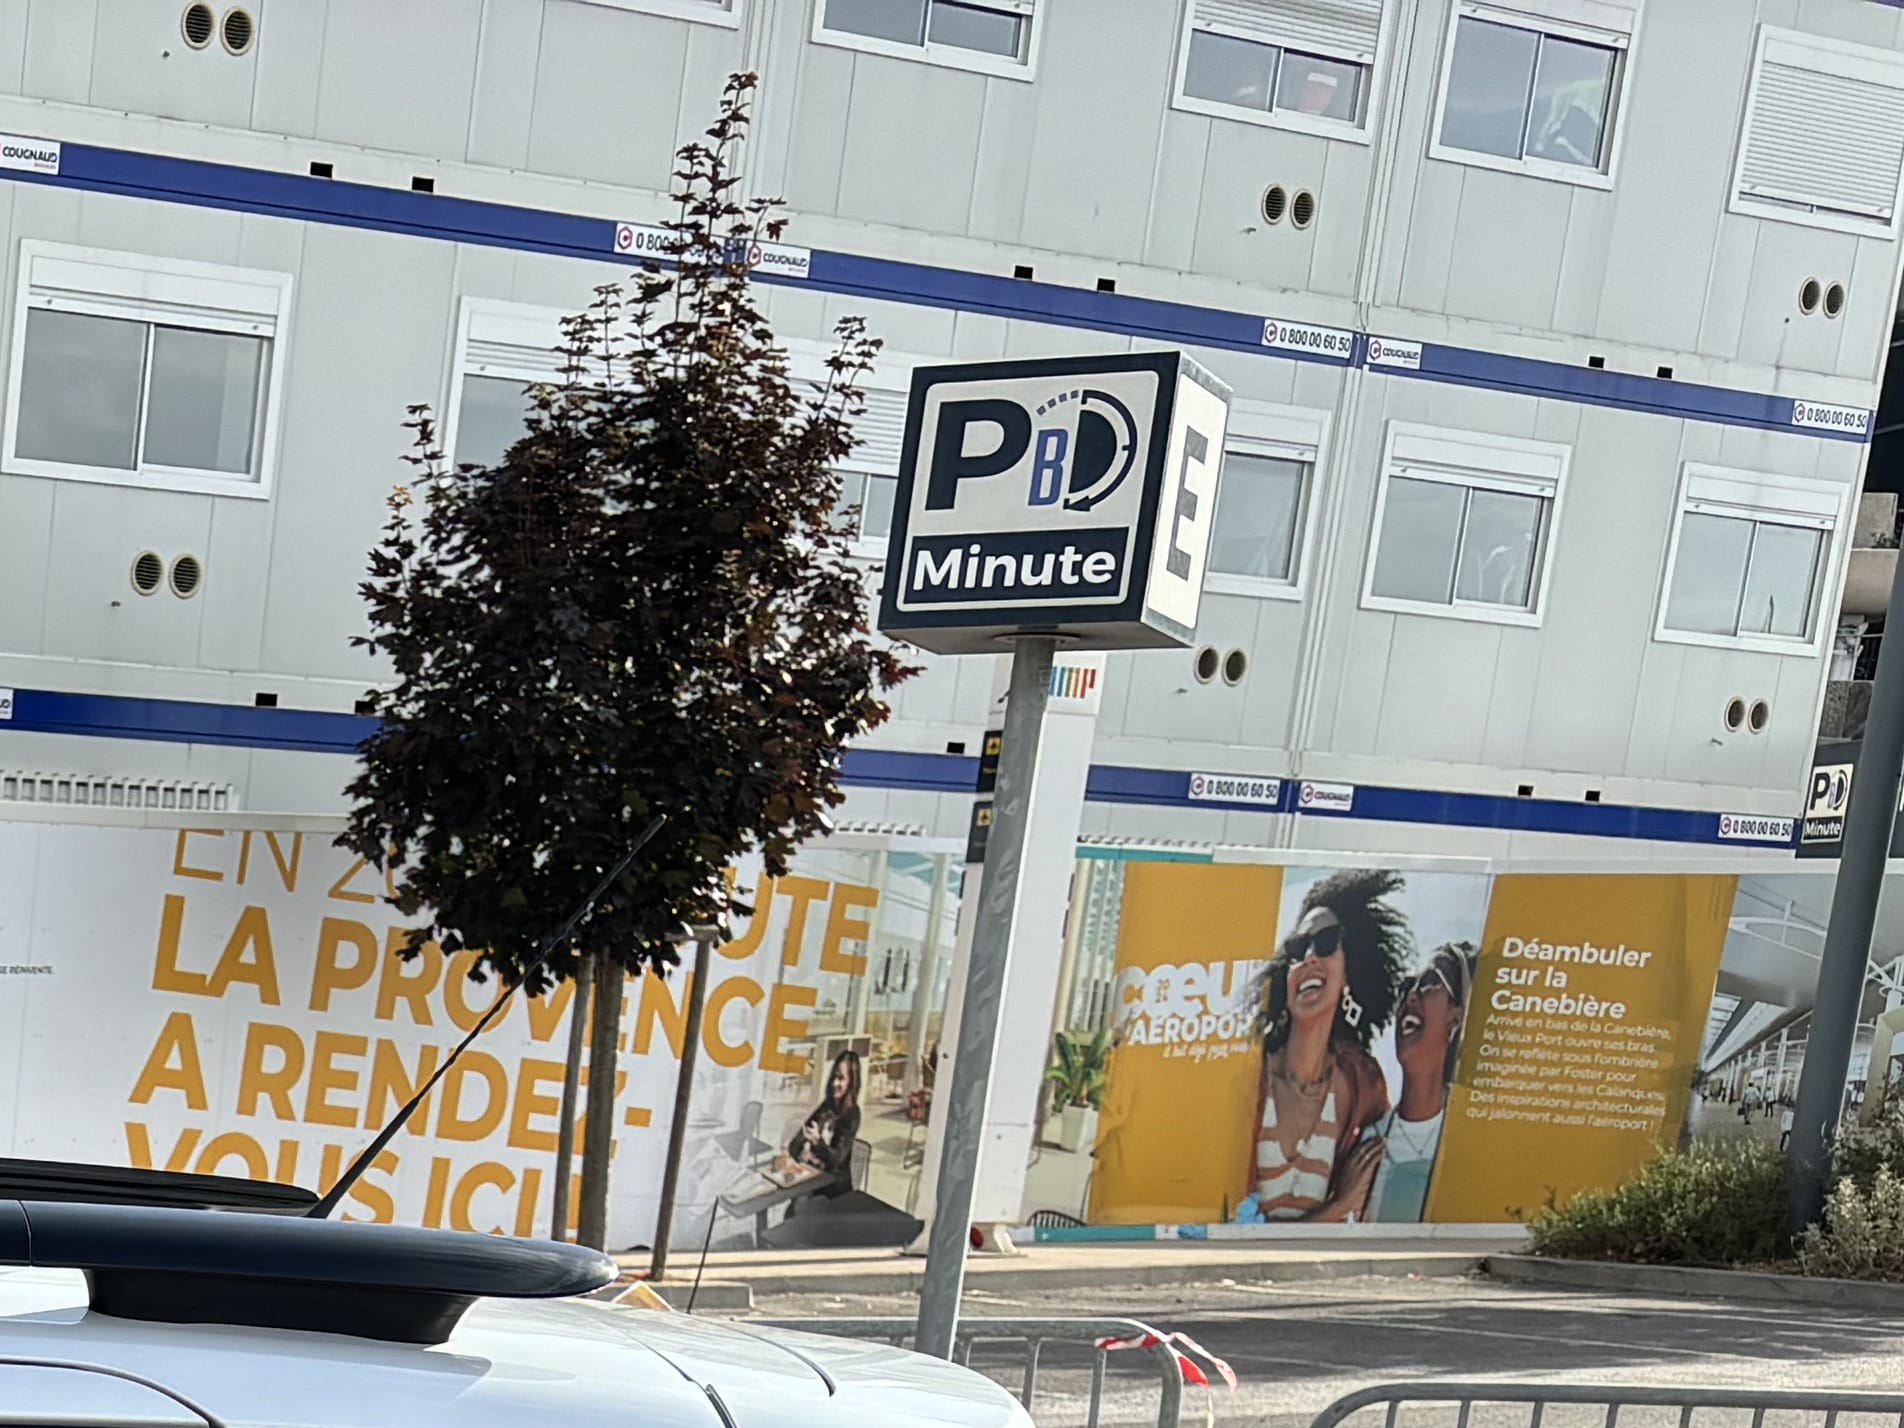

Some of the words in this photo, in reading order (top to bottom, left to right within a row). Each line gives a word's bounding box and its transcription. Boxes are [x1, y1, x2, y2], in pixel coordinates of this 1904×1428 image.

[1, 145, 58, 163] COUGNAUD
[636, 232, 644, 249] 0
[1280, 327, 1287, 342] 0
[1289, 329, 1308, 345] 800
[1309, 333, 1322, 348] 00
[1324, 335, 1337, 350] 60
[1338, 337, 1351, 353] 50
[913, 543, 1116, 591] Minute
[1804, 819, 1841, 837] Minute
[714, 866, 880, 977] UTE
[151, 894, 281, 1006] LA
[1502, 937, 1652, 968] Déambuler
[1495, 967, 1539, 986] sur
[1545, 966, 1568, 988] la
[1491, 988, 1626, 1019] Canebière
[1486, 1013, 1525, 1029] Arrivé
[1526, 1017, 1543, 1029] en
[1545, 1017, 1569, 1031] bas
[1570, 1019, 1588, 1032] de
[1590, 1020, 1601, 1033] la
[1497, 1030, 1532, 1043] Vieux
[1535, 1032, 1562, 1046] Port
[1565, 1036, 1602, 1049] ouvre
[1604, 1039, 1625, 1051] ses
[128, 1010, 209, 1113] A
[1479, 1044, 1500, 1057] On
[1503, 1047, 1517, 1058] se
[1519, 1047, 1560, 1062] reflète
[1562, 1051, 1591, 1064] sous
[1539, 1064, 1562, 1078] par
[1564, 1065, 1603, 1081] Foster
[1605, 1069, 1637, 1084] pour
[1473, 1076, 1545, 1093] embarquer
[1547, 1082, 1574, 1094] vers
[1470, 1090, 1494, 1103] Des
[1466, 1107, 1487, 1120] qui
[1552, 1112, 1586, 1126] aussi
